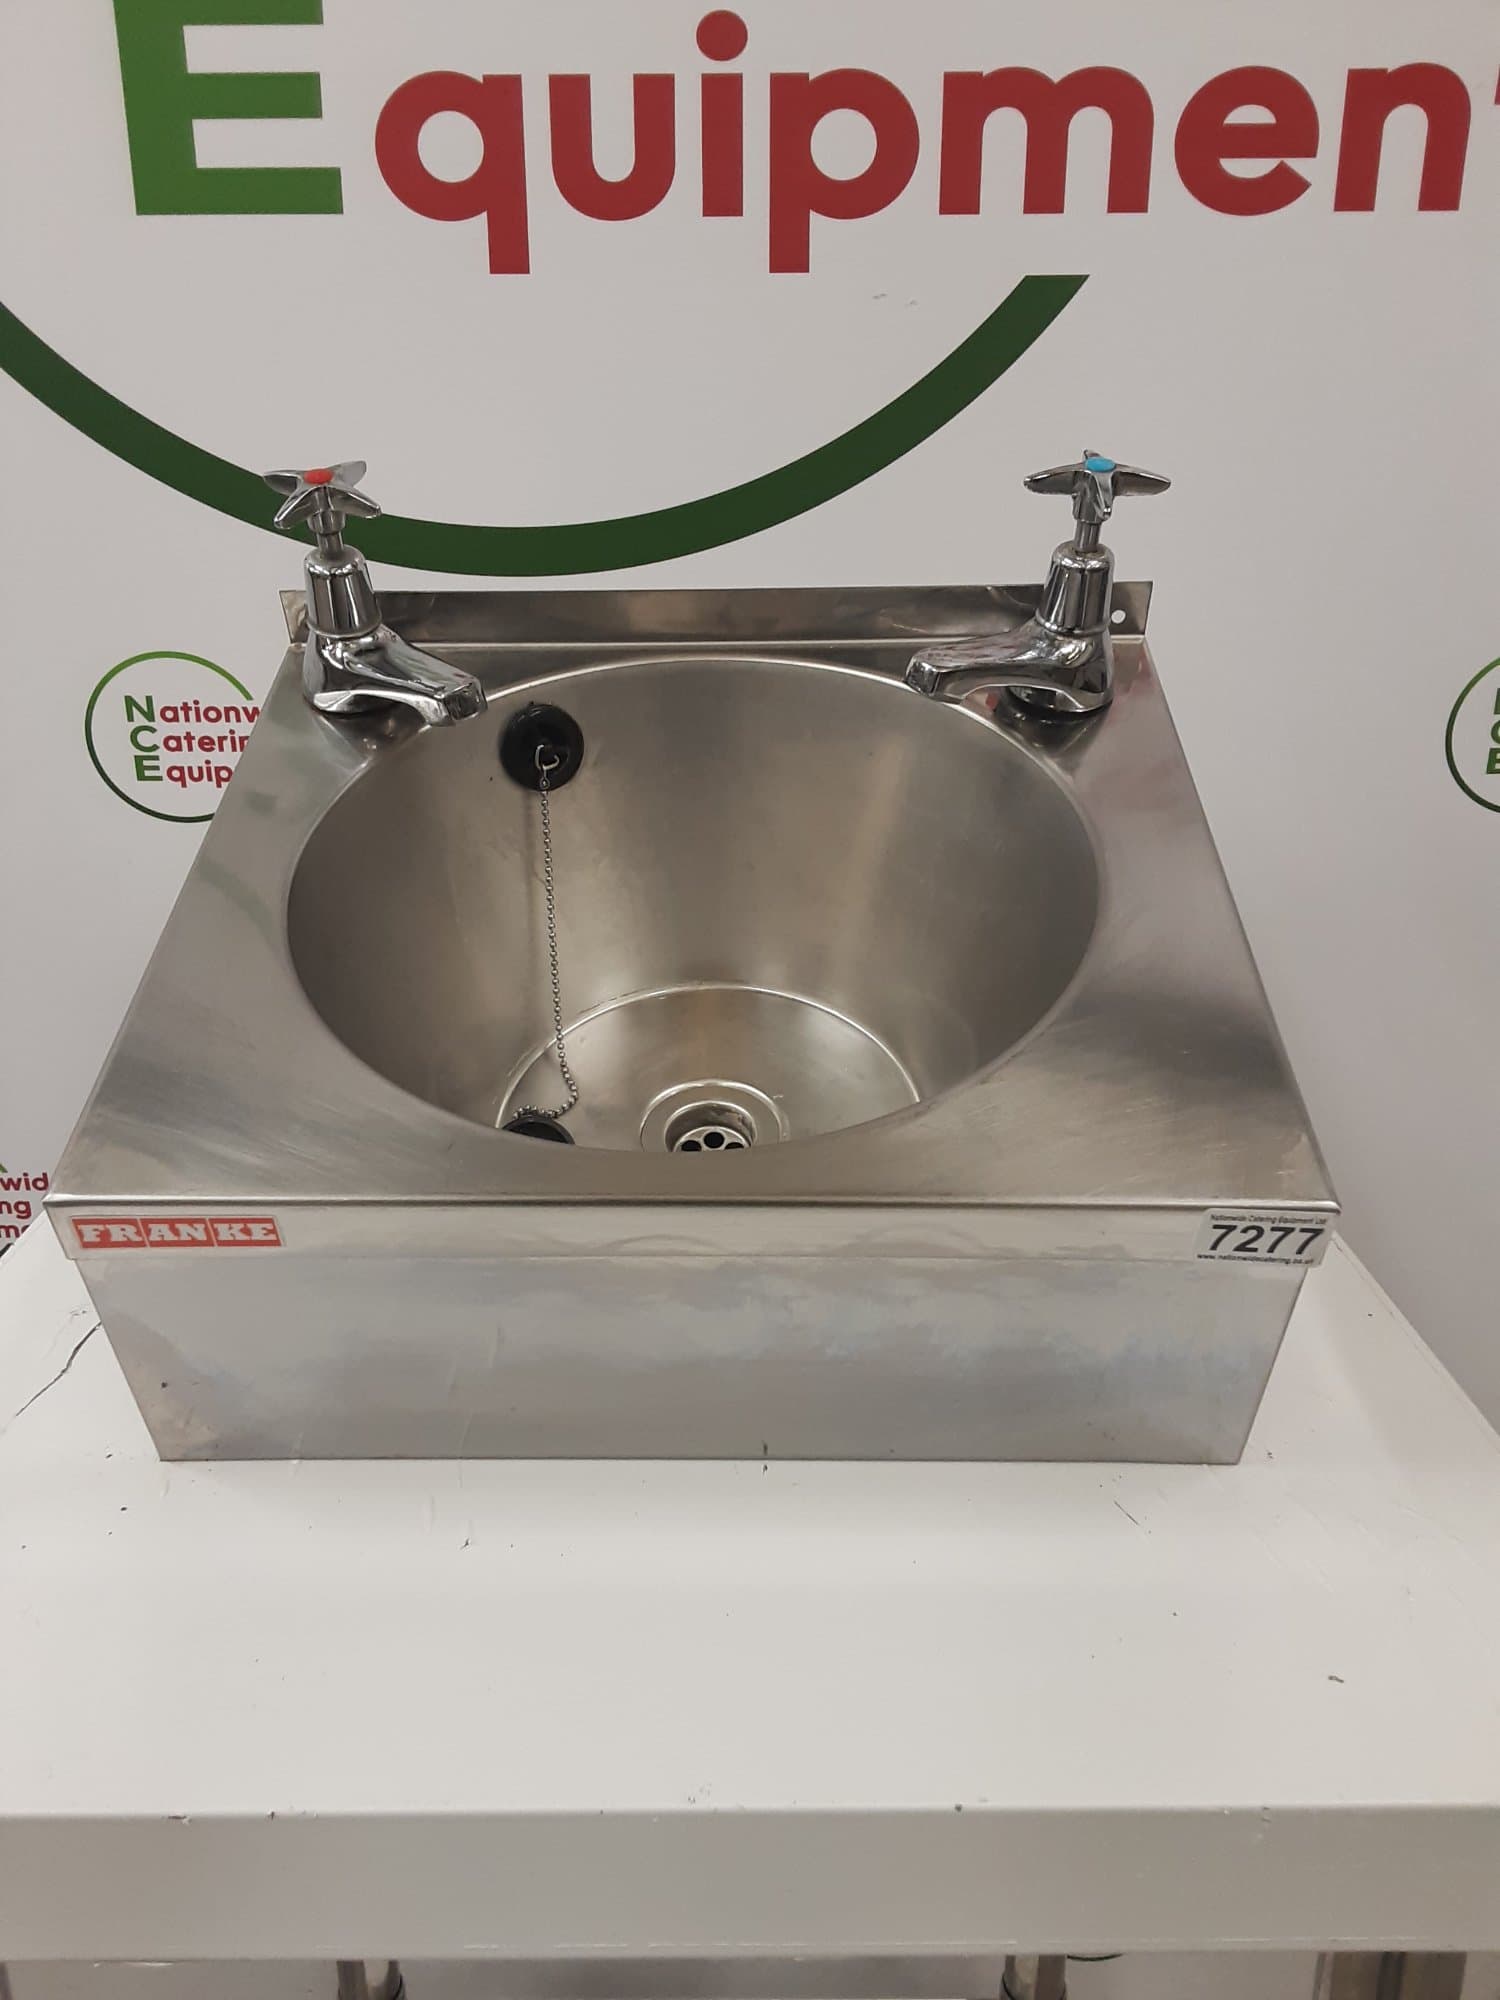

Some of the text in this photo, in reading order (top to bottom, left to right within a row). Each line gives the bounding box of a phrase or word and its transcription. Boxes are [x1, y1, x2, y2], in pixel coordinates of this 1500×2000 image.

[115, 0, 1500, 273] Equipmen
[78, 1222, 278, 1243] FRANKE
[1209, 1224, 1324, 1255] 7277
